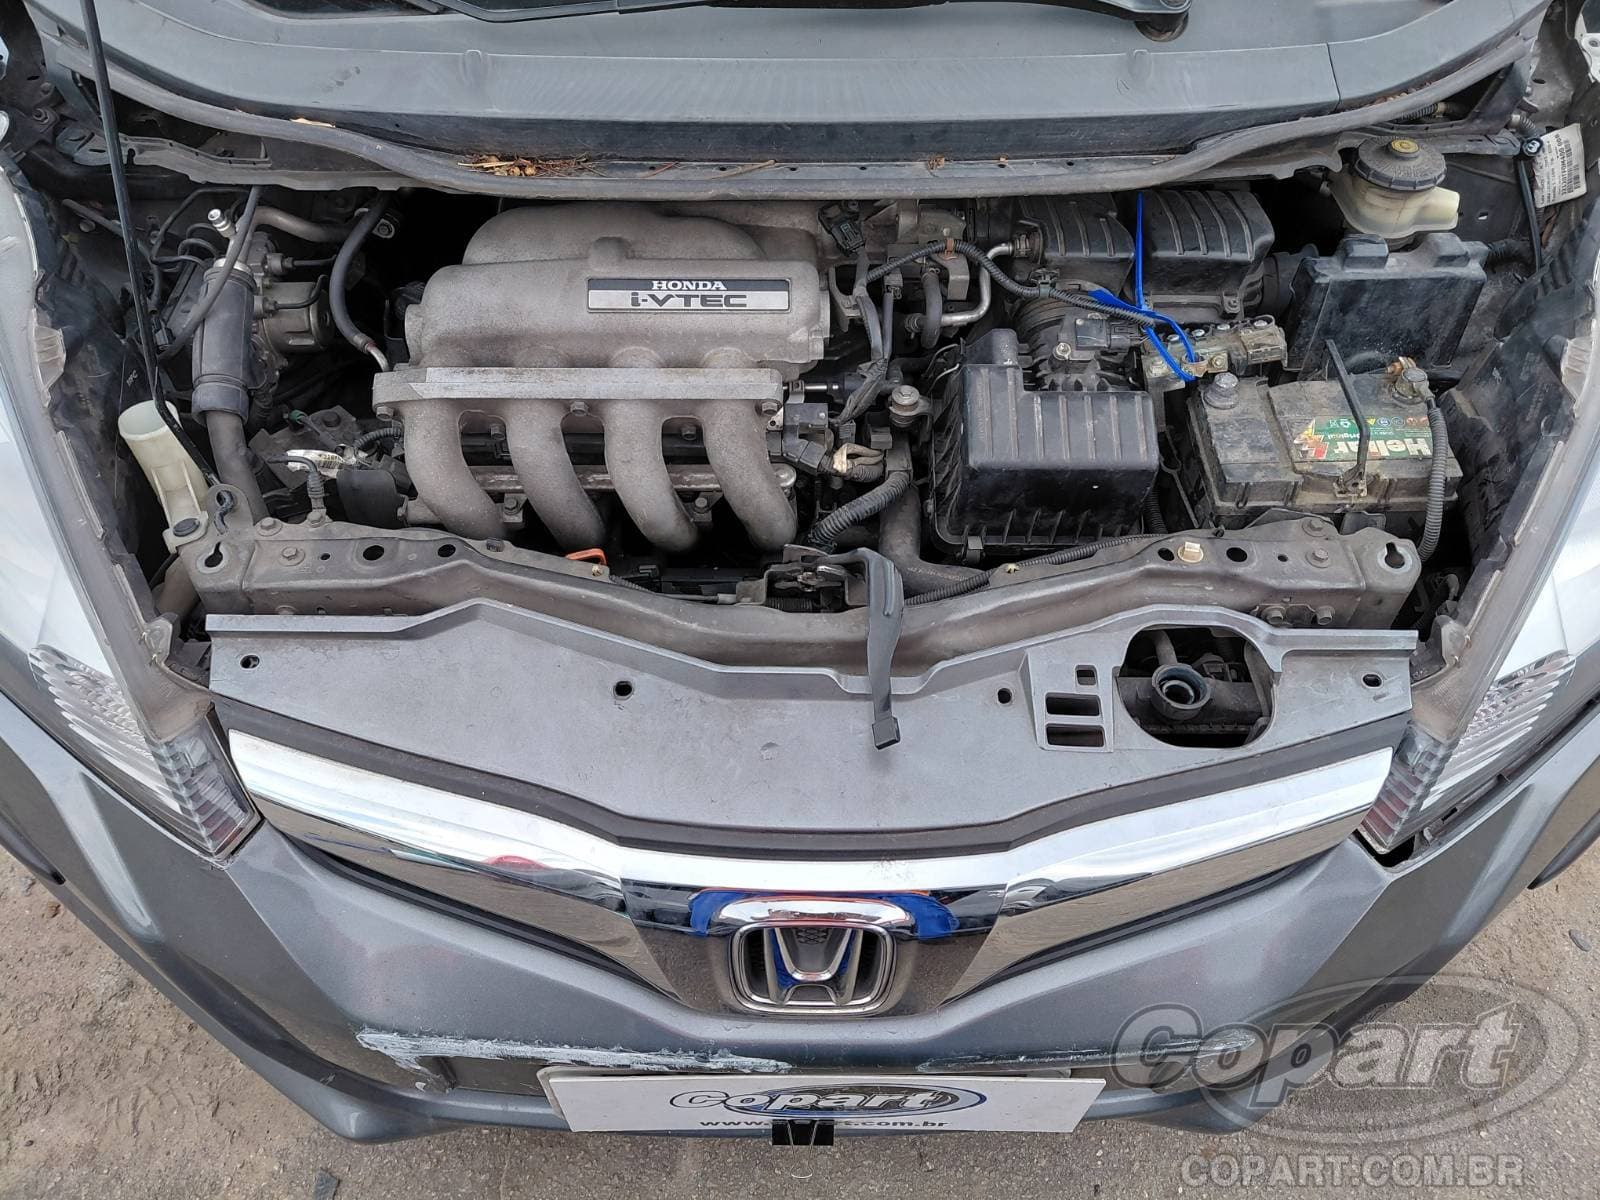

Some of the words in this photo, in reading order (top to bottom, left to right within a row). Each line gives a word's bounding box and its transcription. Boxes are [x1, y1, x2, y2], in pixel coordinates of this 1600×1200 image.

[651, 280, 727, 290] HONDA
[631, 292, 747, 307] i-VTEC
[669, 1090, 950, 1112] Copart
